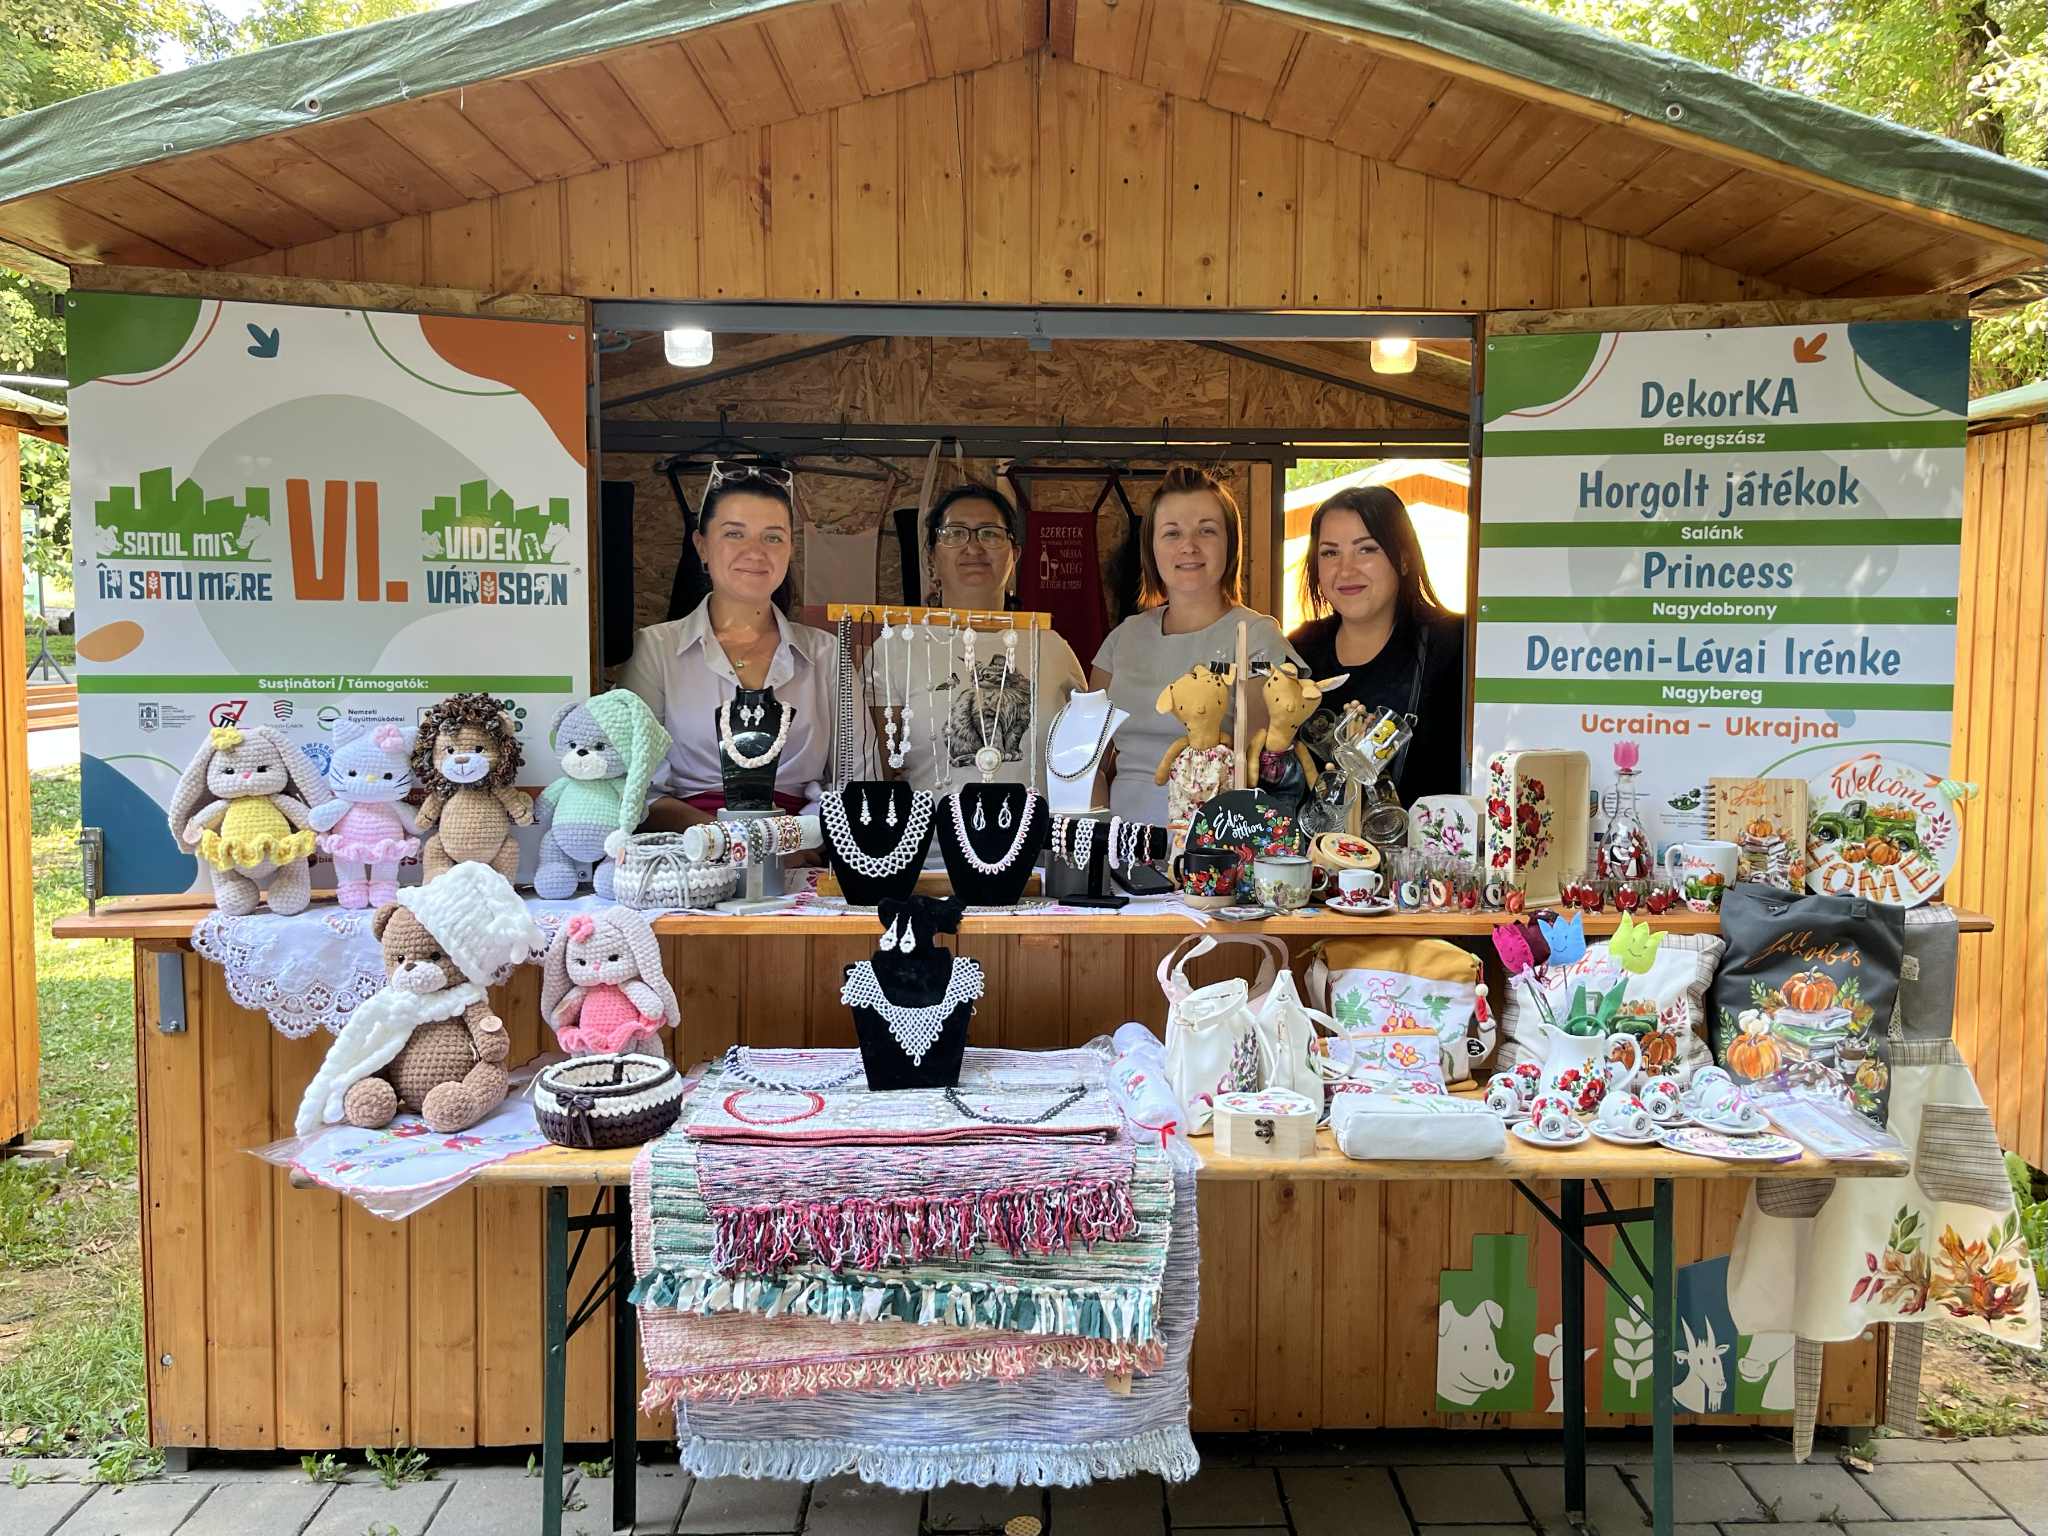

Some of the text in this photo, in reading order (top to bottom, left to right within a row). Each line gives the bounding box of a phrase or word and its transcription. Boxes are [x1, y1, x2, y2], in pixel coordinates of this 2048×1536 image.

[1640, 377, 1799, 418] DekorKA
[1663, 430, 1765, 450] Beregszász
[1579, 465, 1860, 518] Horgolt játékok
[123, 532, 188, 557] SATUL
[286, 478, 409, 603] VI.
[444, 521, 522, 561] VIDÉK
[1040, 526, 1084, 539] SZERETEK
[1681, 524, 1743, 541] Salánk
[129, 570, 193, 601] SATU
[199, 571, 273, 602] MARE
[426, 565, 568, 606] VÁROSBAN
[1643, 551, 1794, 589] Princess
[1652, 601, 1777, 621] Nagydobrony
[1526, 635, 1901, 676] Derceni-Lévai Irénke
[347, 677, 429, 692] Támogatók:
[1661, 685, 1764, 705] Nagybereg
[1581, 713, 1690, 736] Ucraina
[1725, 715, 1839, 744] Ukrajna
[1831, 764, 1937, 816] Welcome
